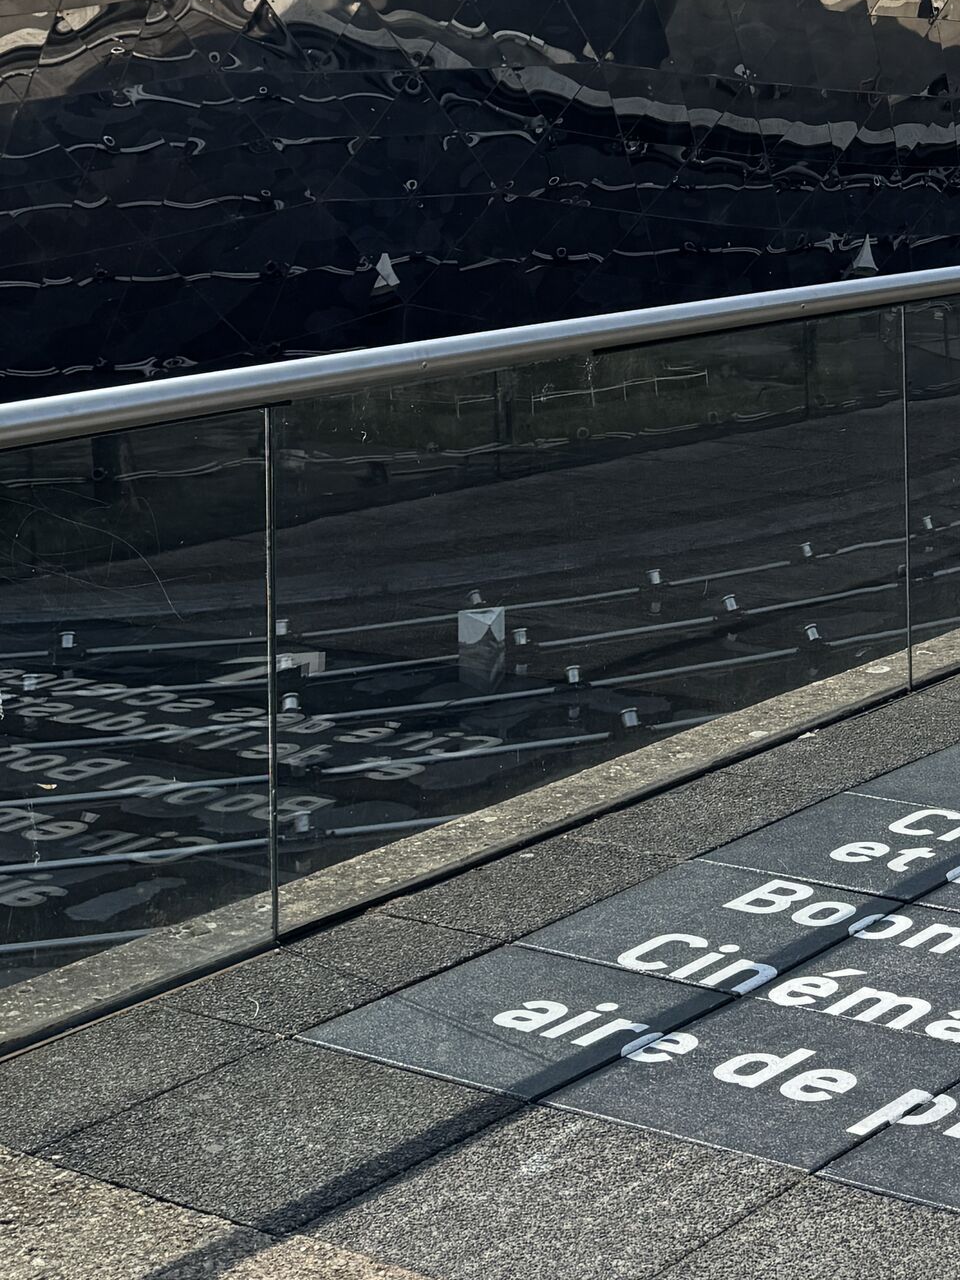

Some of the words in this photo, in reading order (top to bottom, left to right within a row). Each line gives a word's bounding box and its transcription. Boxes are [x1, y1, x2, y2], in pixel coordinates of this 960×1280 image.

[829, 840, 937, 872] et
[492, 999, 699, 1063] aire
[712, 1047, 857, 1102] de
